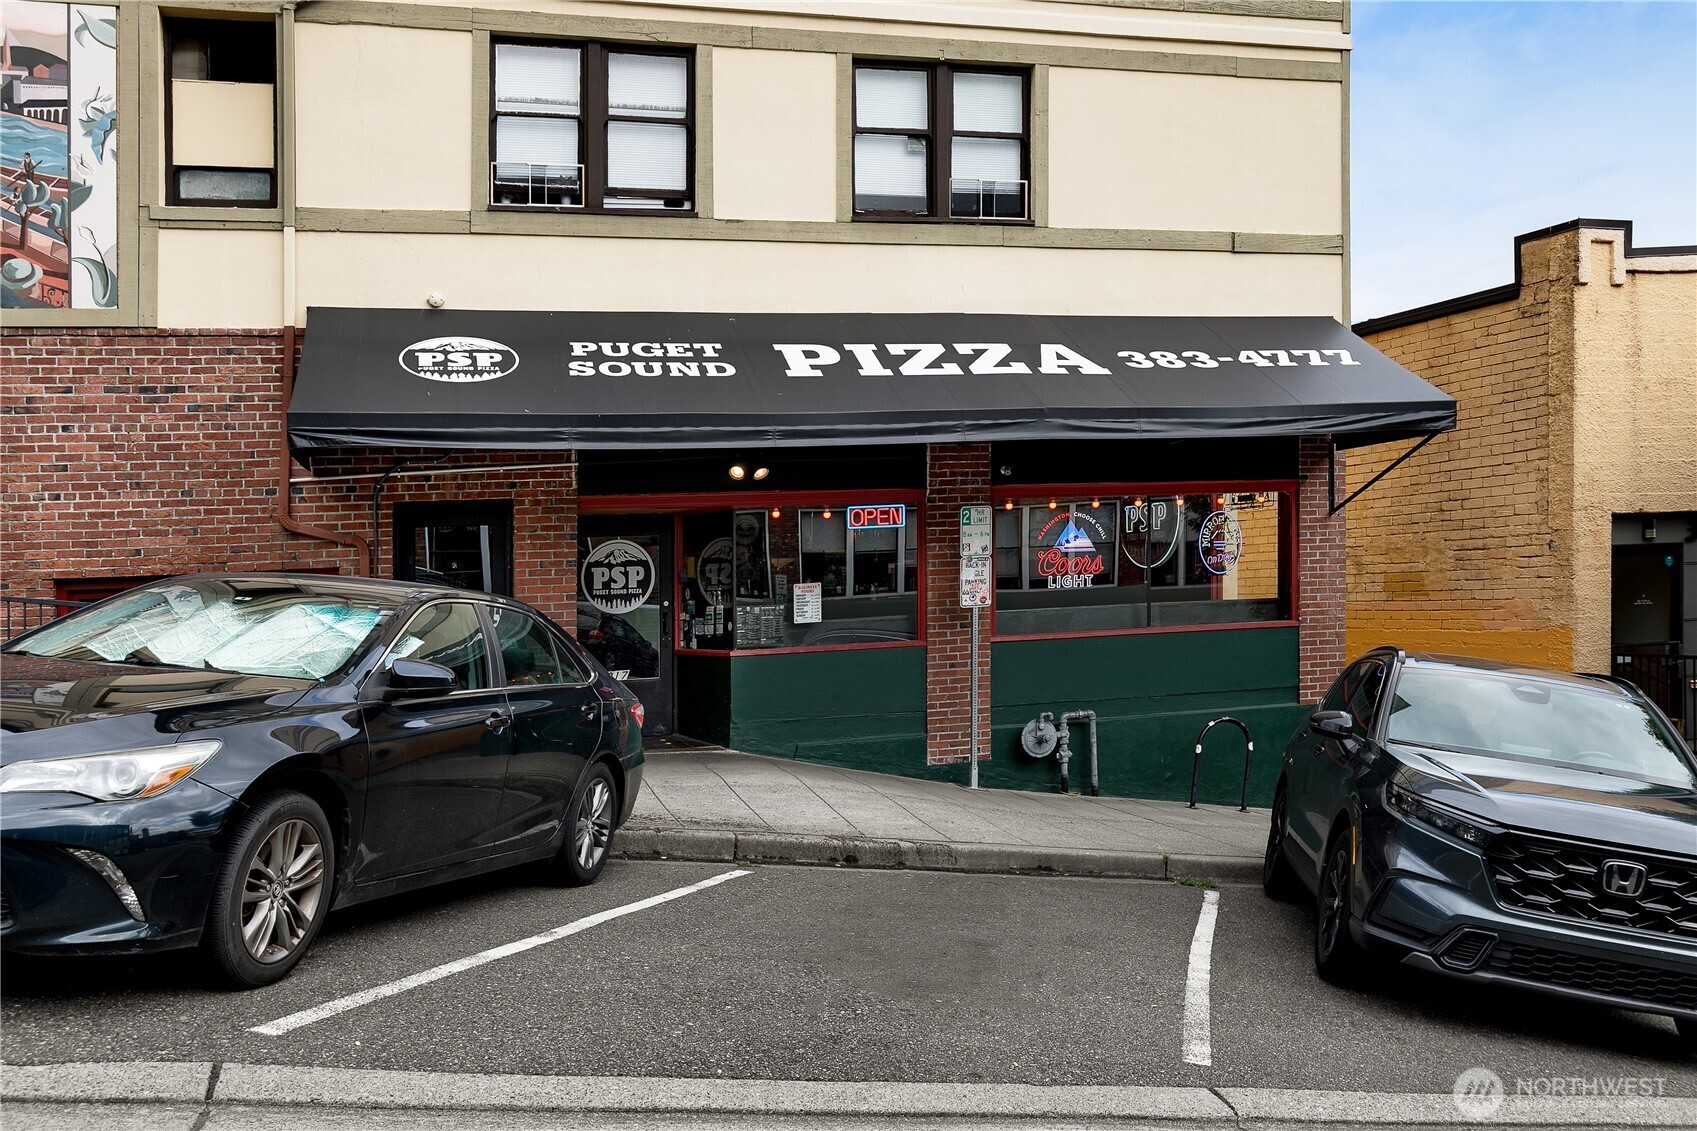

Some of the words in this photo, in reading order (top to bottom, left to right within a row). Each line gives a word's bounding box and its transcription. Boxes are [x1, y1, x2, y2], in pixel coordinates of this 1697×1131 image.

[569, 341, 723, 358] PUGET
[414, 352, 503, 367] PSP
[772, 343, 1113, 377] PIZZA
[1116, 348, 1362, 370] 383-4777
[567, 361, 737, 377] SOUND
[850, 507, 903, 527] OPEN
[963, 510, 970, 523] 2
[973, 516, 988, 524] LIMIT
[1073, 511, 1097, 525] CHOOSE
[1095, 523, 1107, 540] CHILL
[1125, 502, 1167, 533] PSP
[965, 561, 987, 569] BACK-IN
[1037, 548, 1105, 576] Coors
[591, 566, 645, 590] PSP
[1047, 573, 1094, 589] LIGHT
